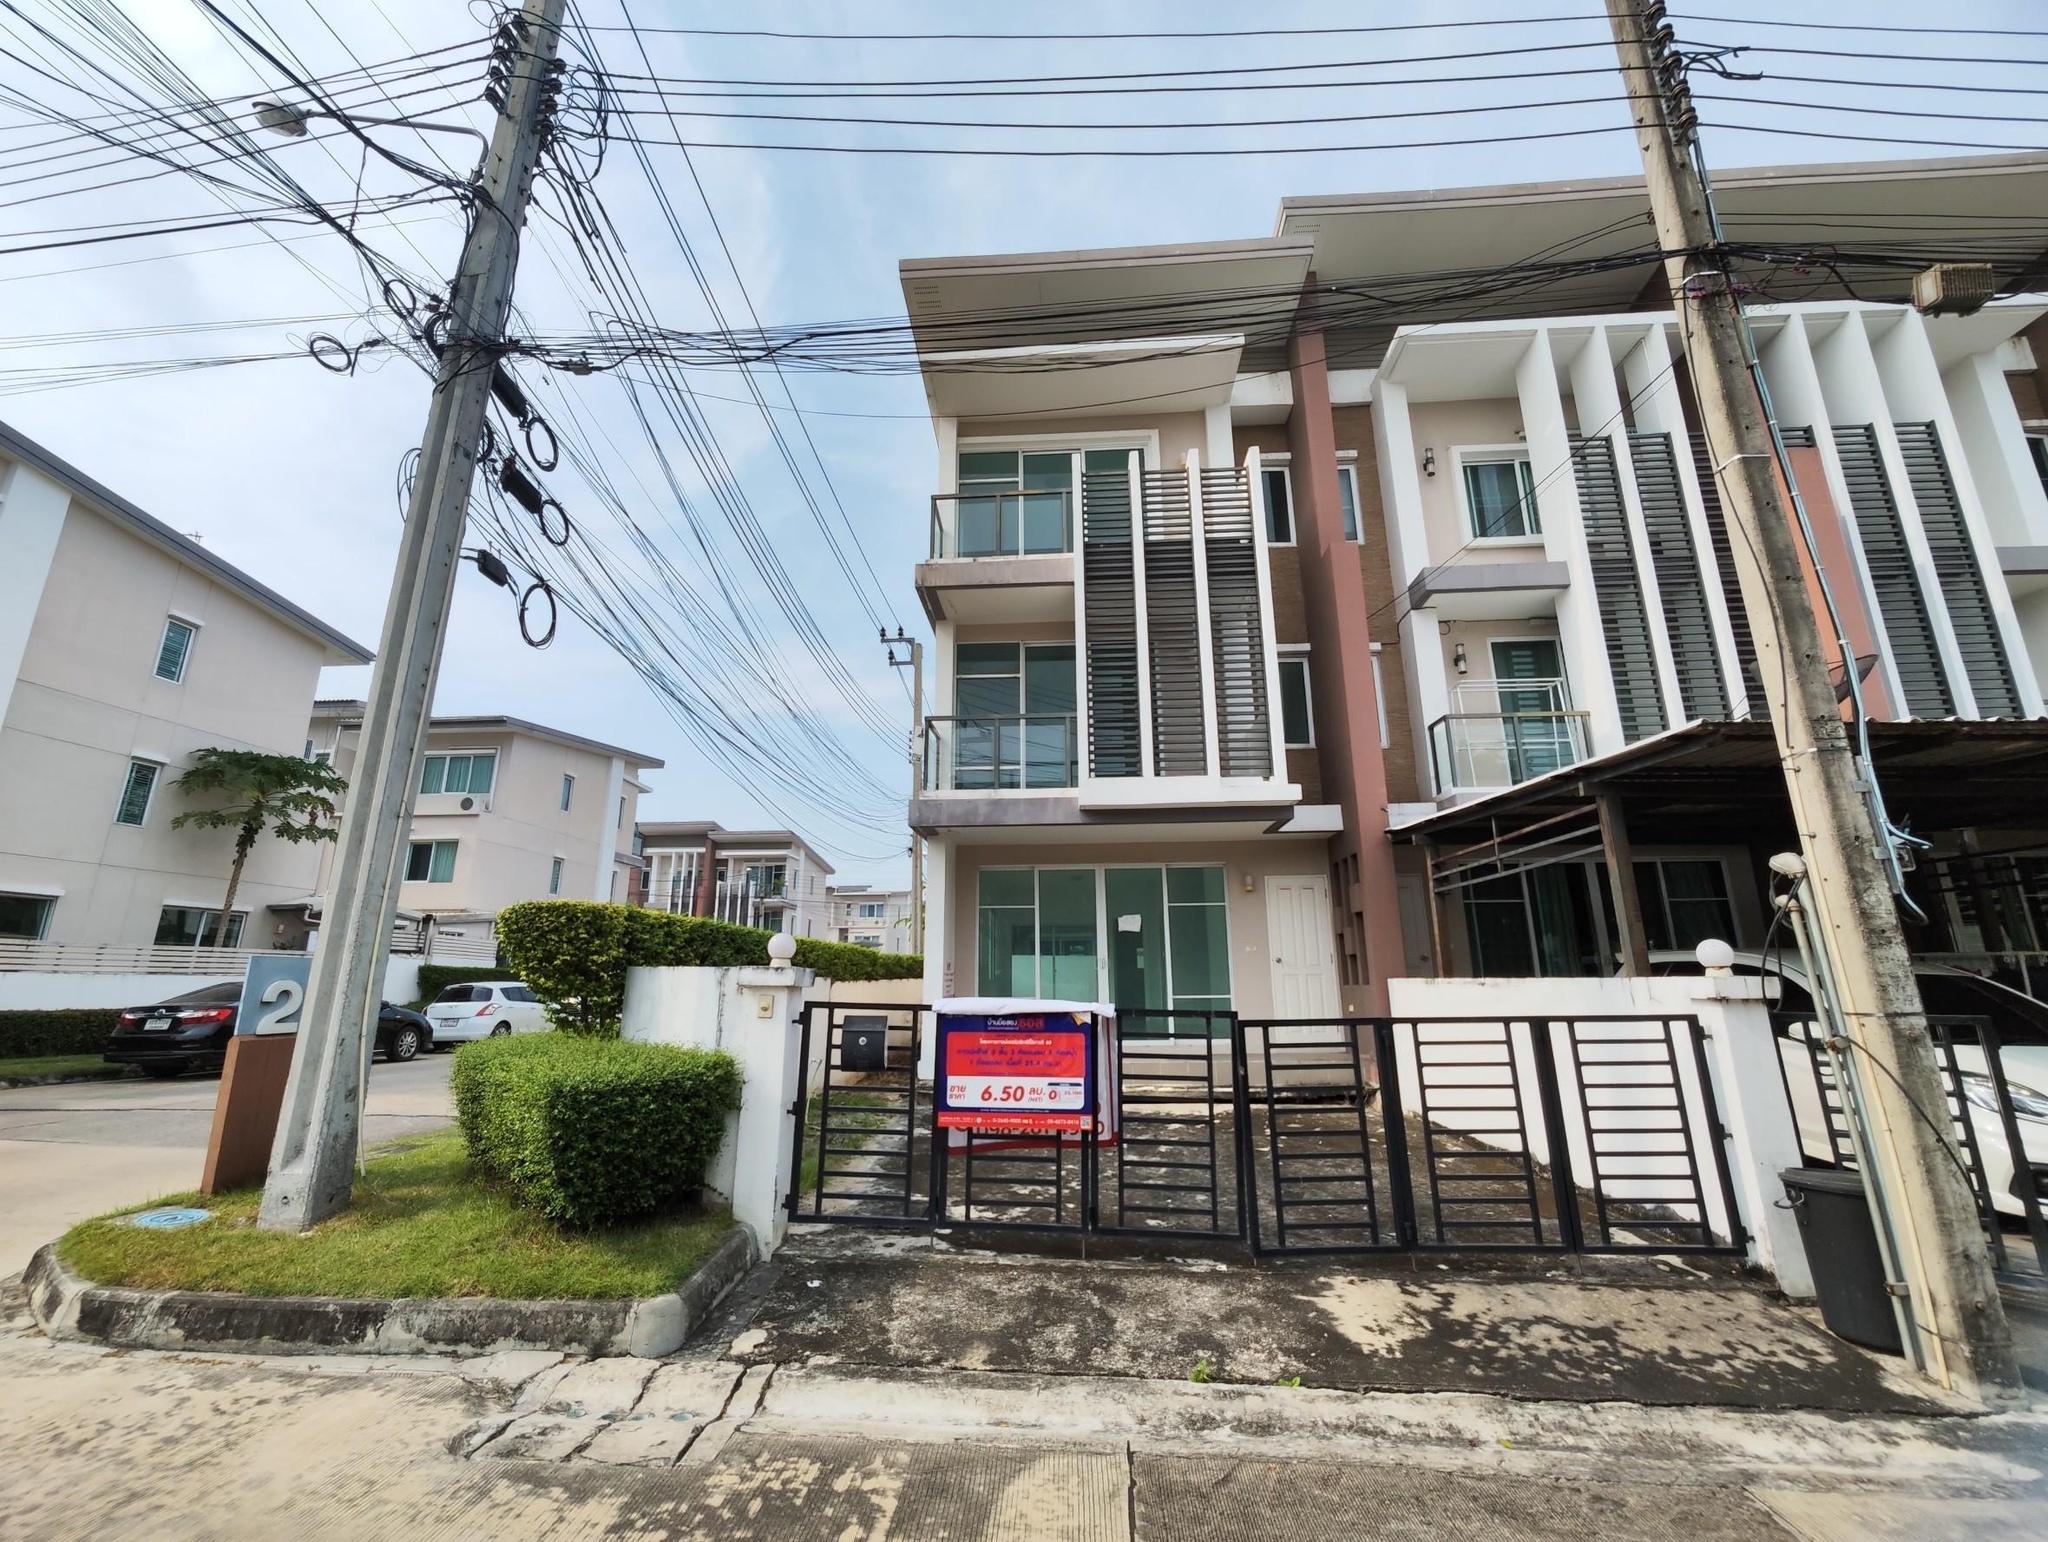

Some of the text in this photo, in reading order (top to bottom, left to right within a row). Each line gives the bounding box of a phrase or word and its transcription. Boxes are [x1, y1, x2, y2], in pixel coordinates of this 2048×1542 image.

[255, 979, 304, 1035] 2
[949, 1084, 967, 1092] ขาย
[981, 1085, 1025, 1102] 6.50
[1048, 1090, 1058, 1100] 0
